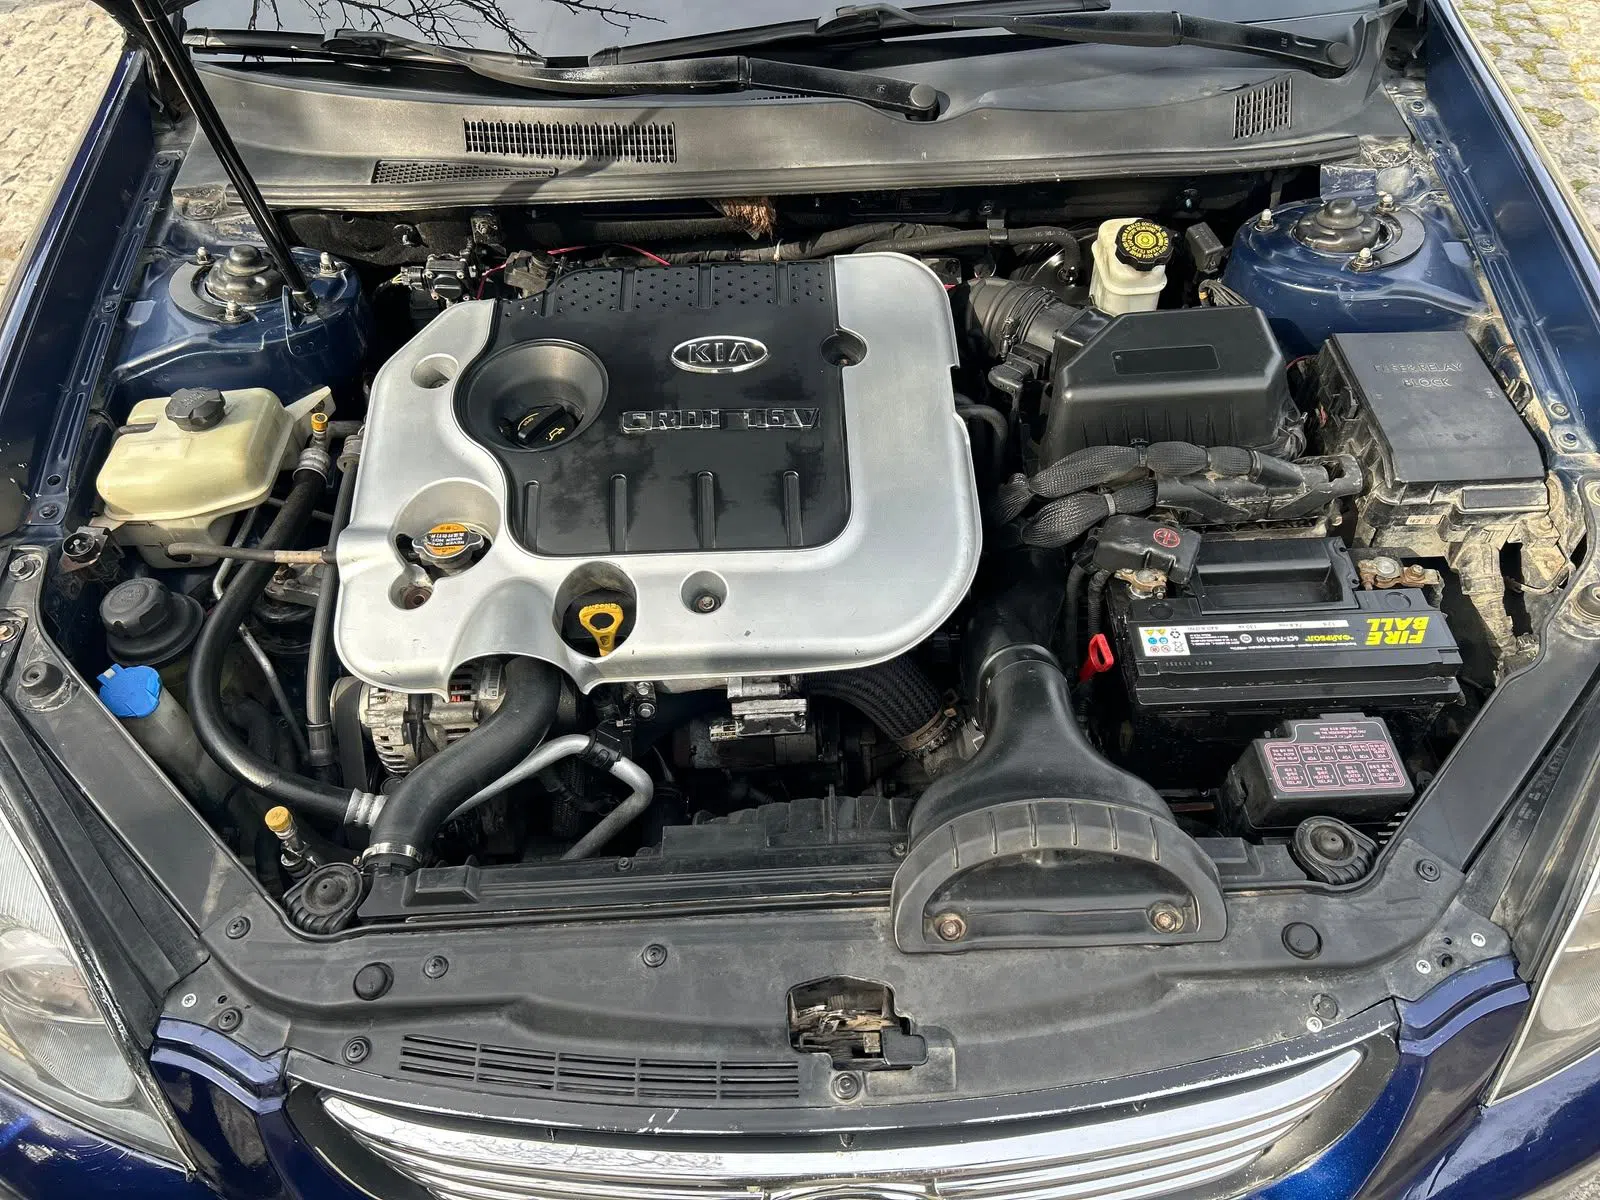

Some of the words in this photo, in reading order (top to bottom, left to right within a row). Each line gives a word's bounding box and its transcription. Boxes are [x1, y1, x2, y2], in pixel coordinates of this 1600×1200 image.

[687, 342, 752, 363] KIA
[1403, 378, 1453, 388] BLOCK
[1366, 616, 1430, 632] BALL
[1365, 630, 1426, 646] FIRE
